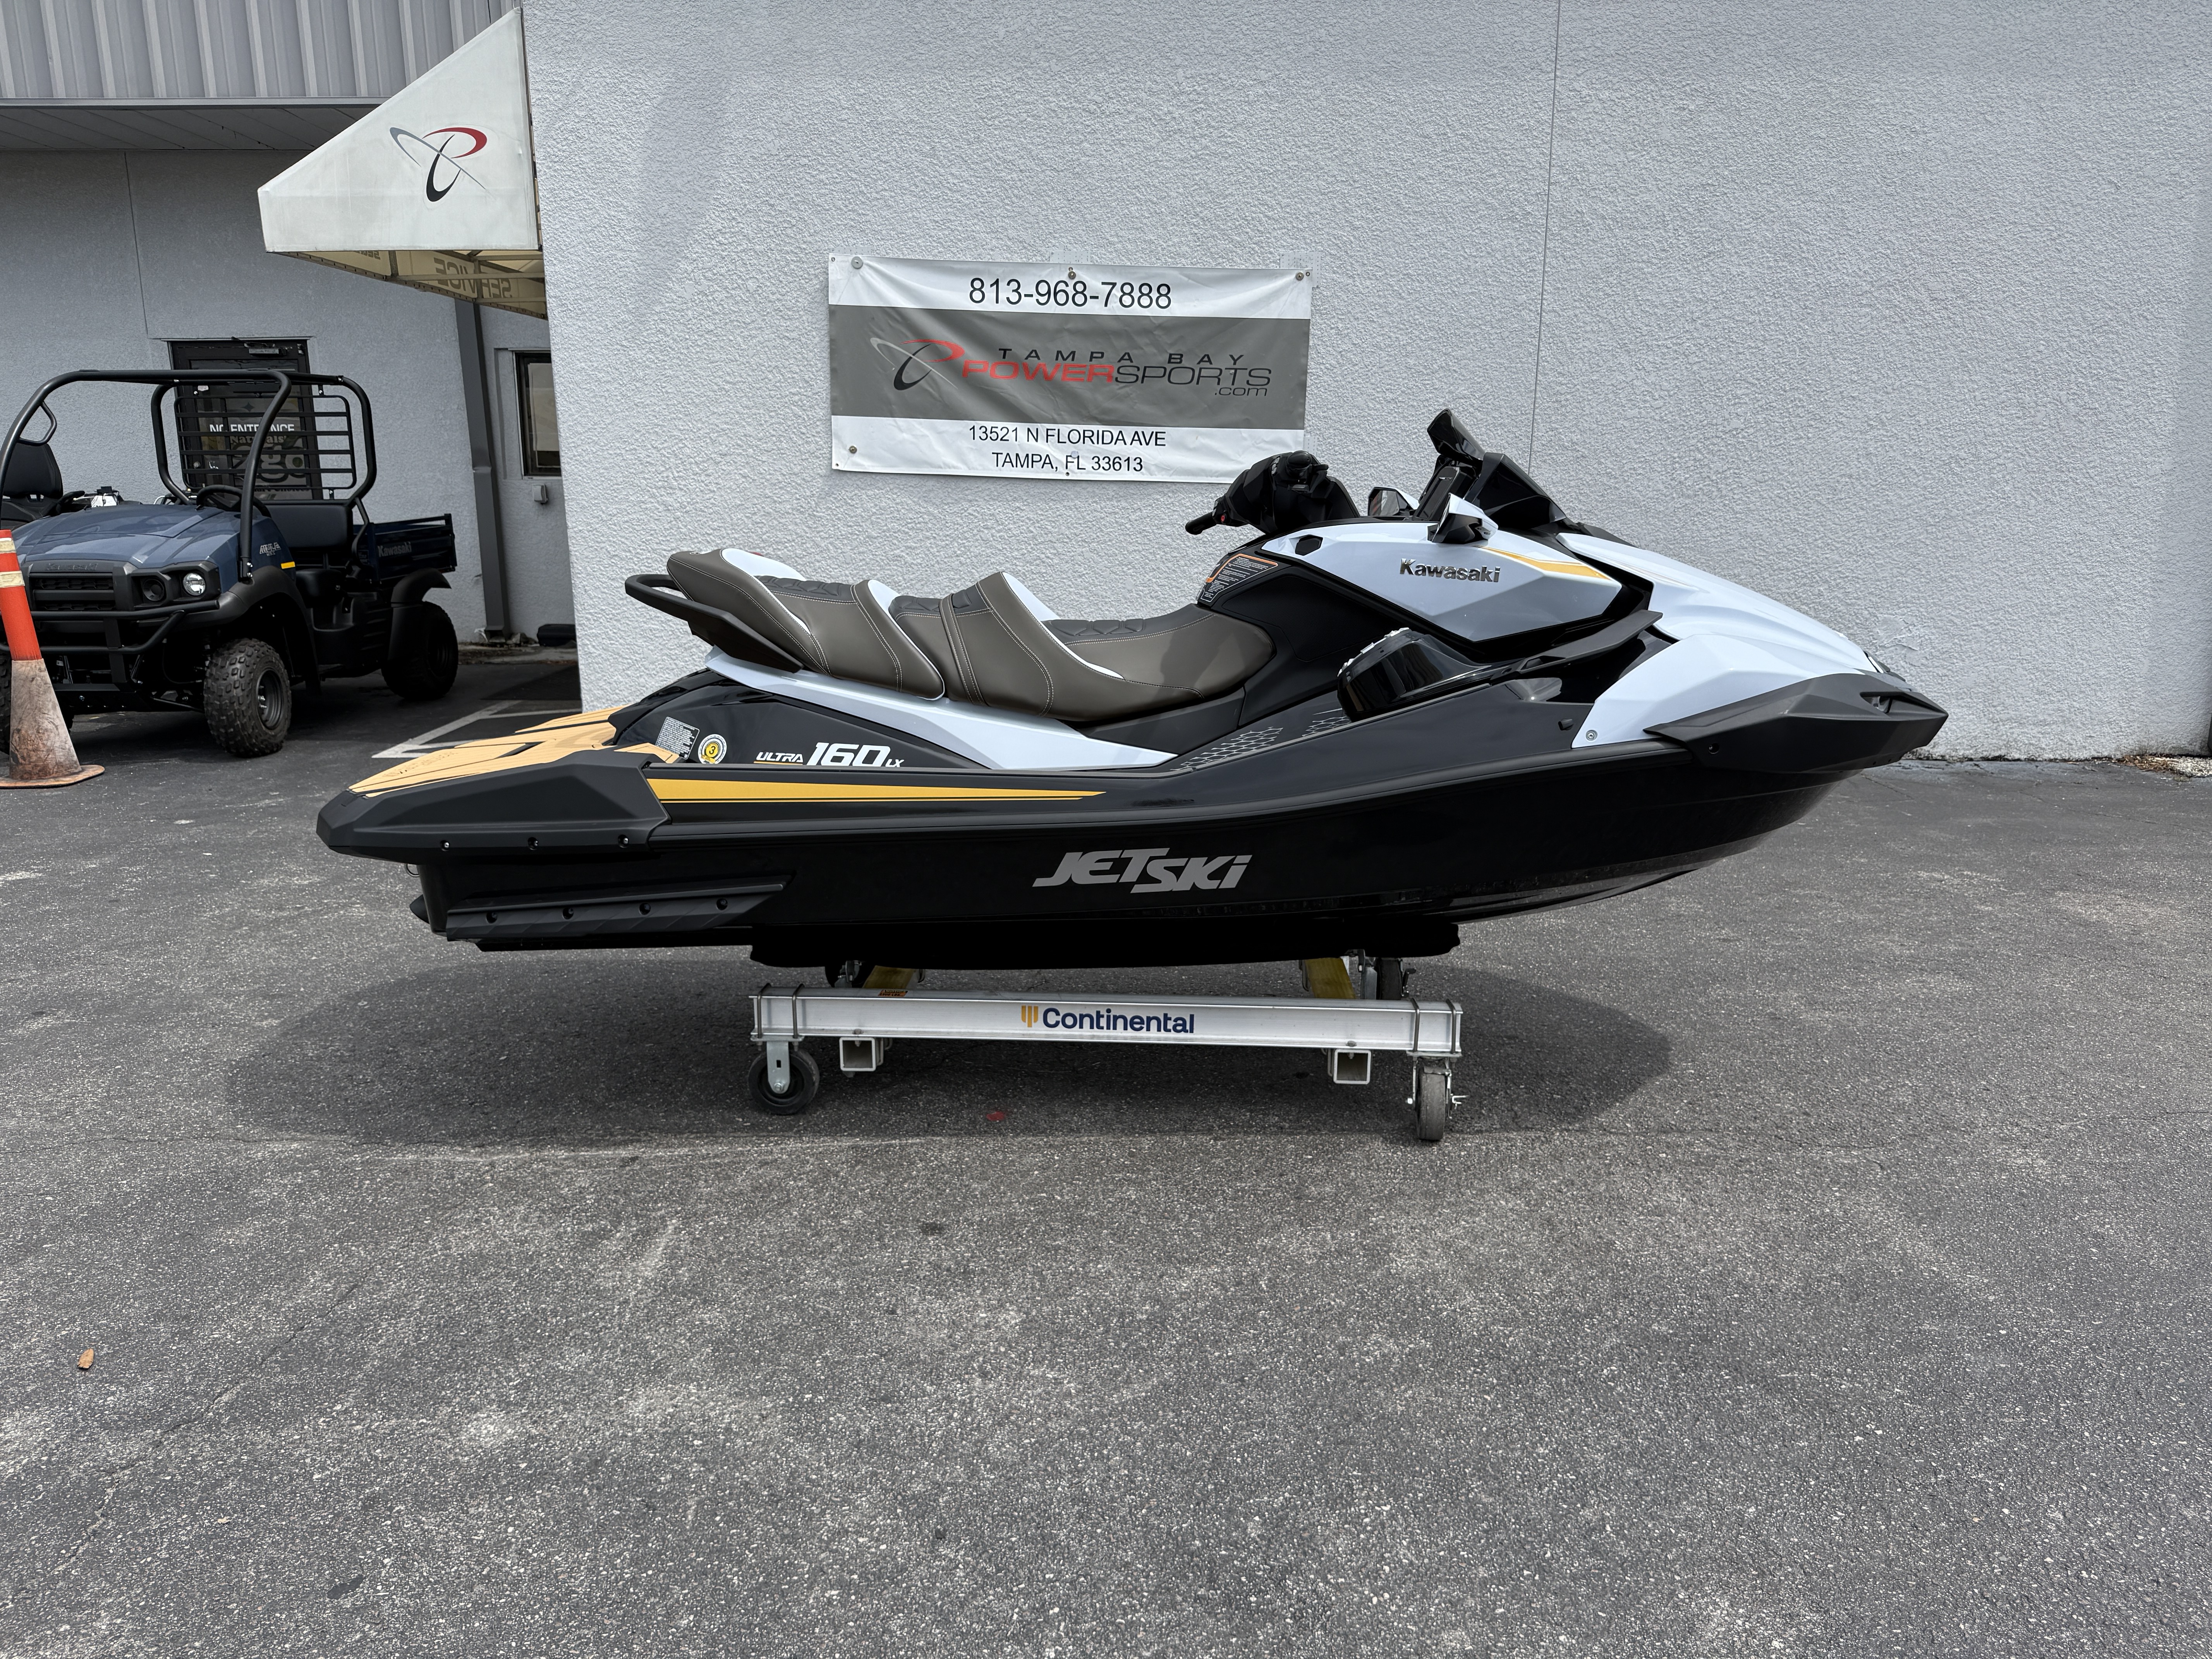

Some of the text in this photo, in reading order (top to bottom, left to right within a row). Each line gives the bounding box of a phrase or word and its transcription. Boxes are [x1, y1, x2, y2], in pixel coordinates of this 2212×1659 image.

[969, 277, 1171, 309] 813-968-7888
[999, 348, 1244, 365] TAMPA BAY
[962, 360, 1271, 386] POWERSPORTS
[1215, 387, 1267, 396] .com
[230, 424, 295, 432] ENTNCE
[969, 426, 1166, 446] 13521 N FLORIDA AVE
[992, 452, 1143, 472] TAMPA, FL 33613
[259, 542, 281, 554] MULE
[377, 541, 412, 557] Kawasaki
[1400, 558, 1501, 582] Kawasaki
[709, 746, 716, 755] 3
[756, 752, 804, 763] ULTRA
[807, 742, 891, 767] 160
[1043, 1008, 1194, 1033] Continental
